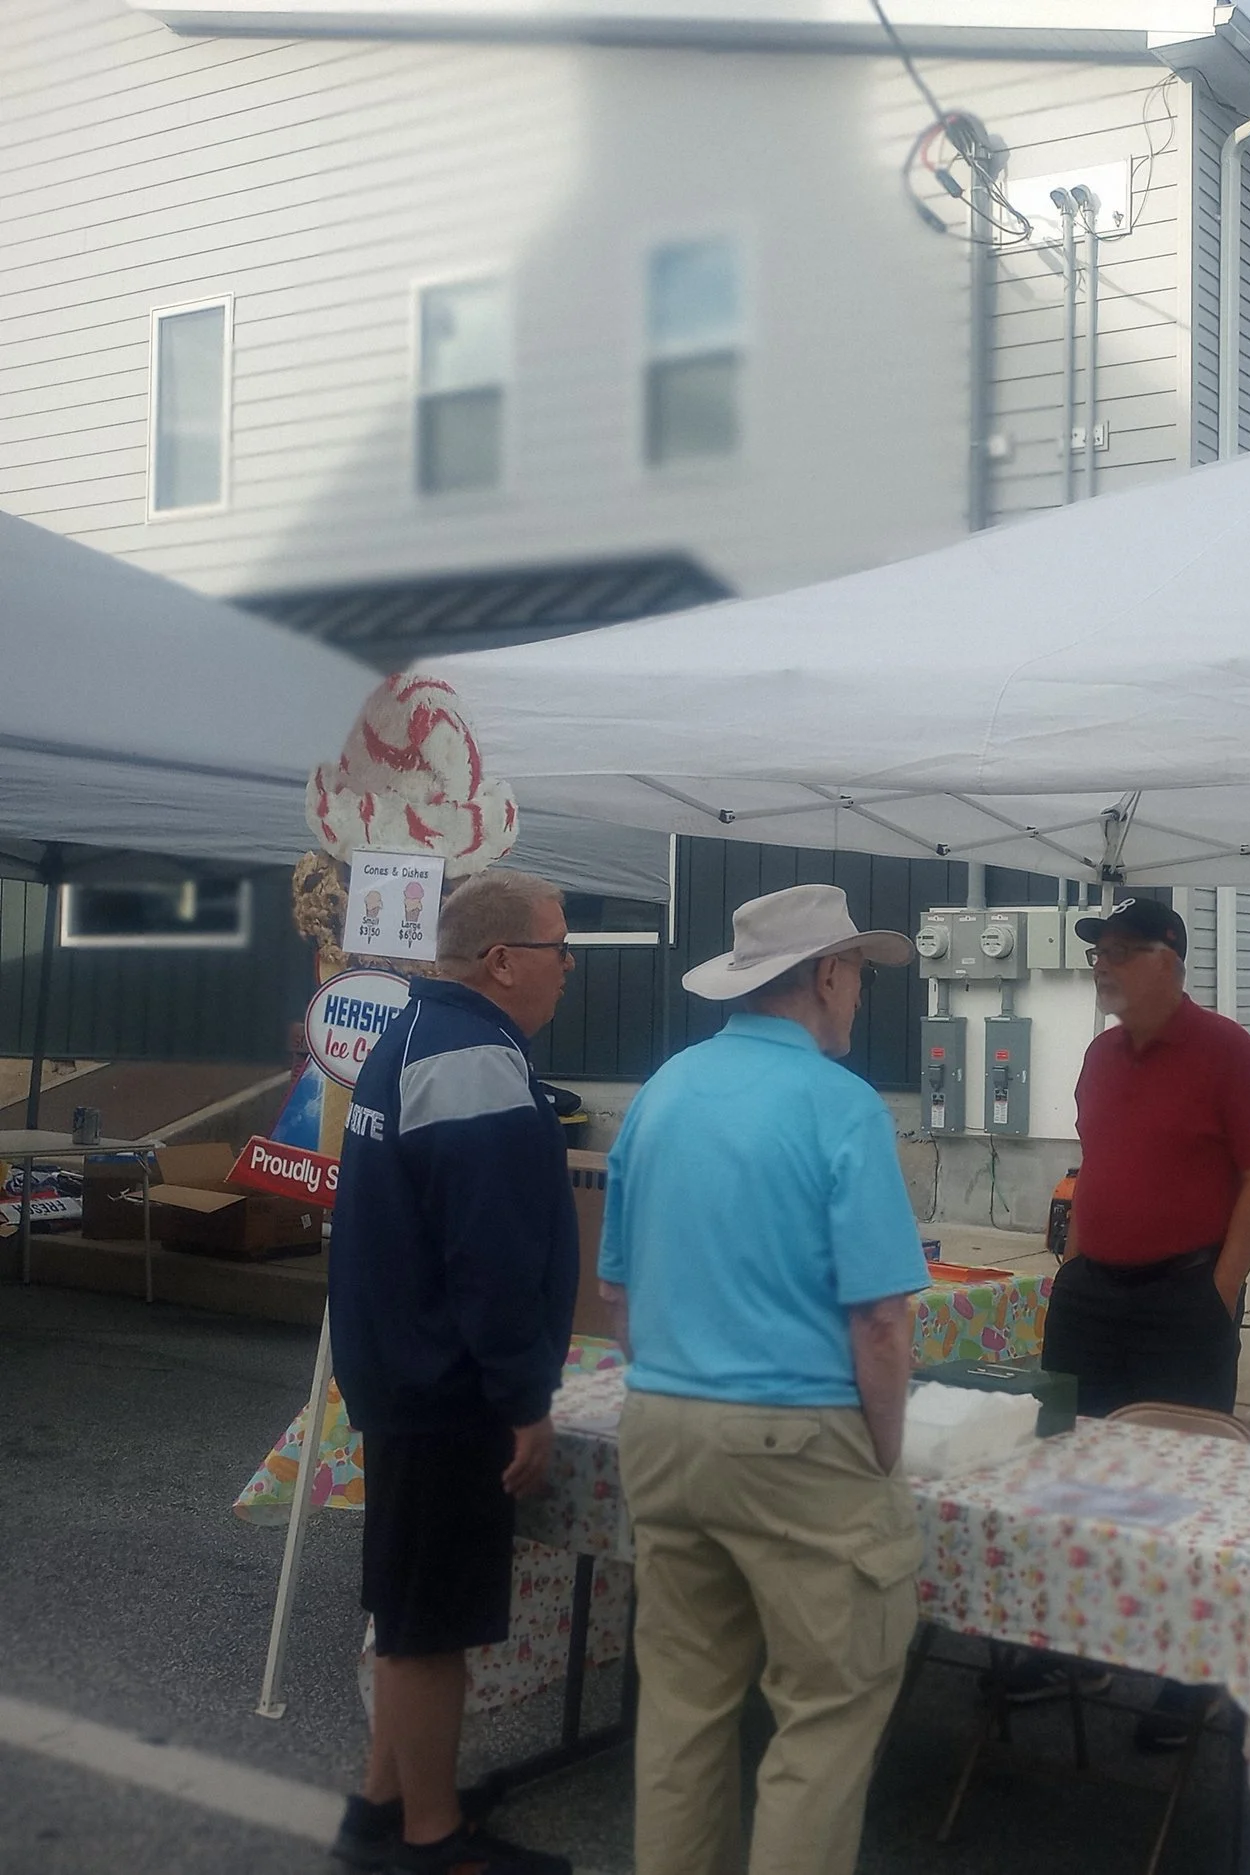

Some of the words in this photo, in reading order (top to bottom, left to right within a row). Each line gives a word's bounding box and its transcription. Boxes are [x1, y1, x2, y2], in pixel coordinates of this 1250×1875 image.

[363, 864, 389, 876] Cones
[391, 867, 398, 876] &
[402, 868, 429, 879] Dishes
[401, 920, 422, 932] Large
[325, 1028, 350, 1059] Ice
[352, 1036, 372, 1063] C
[250, 1145, 322, 1193] Proudly
